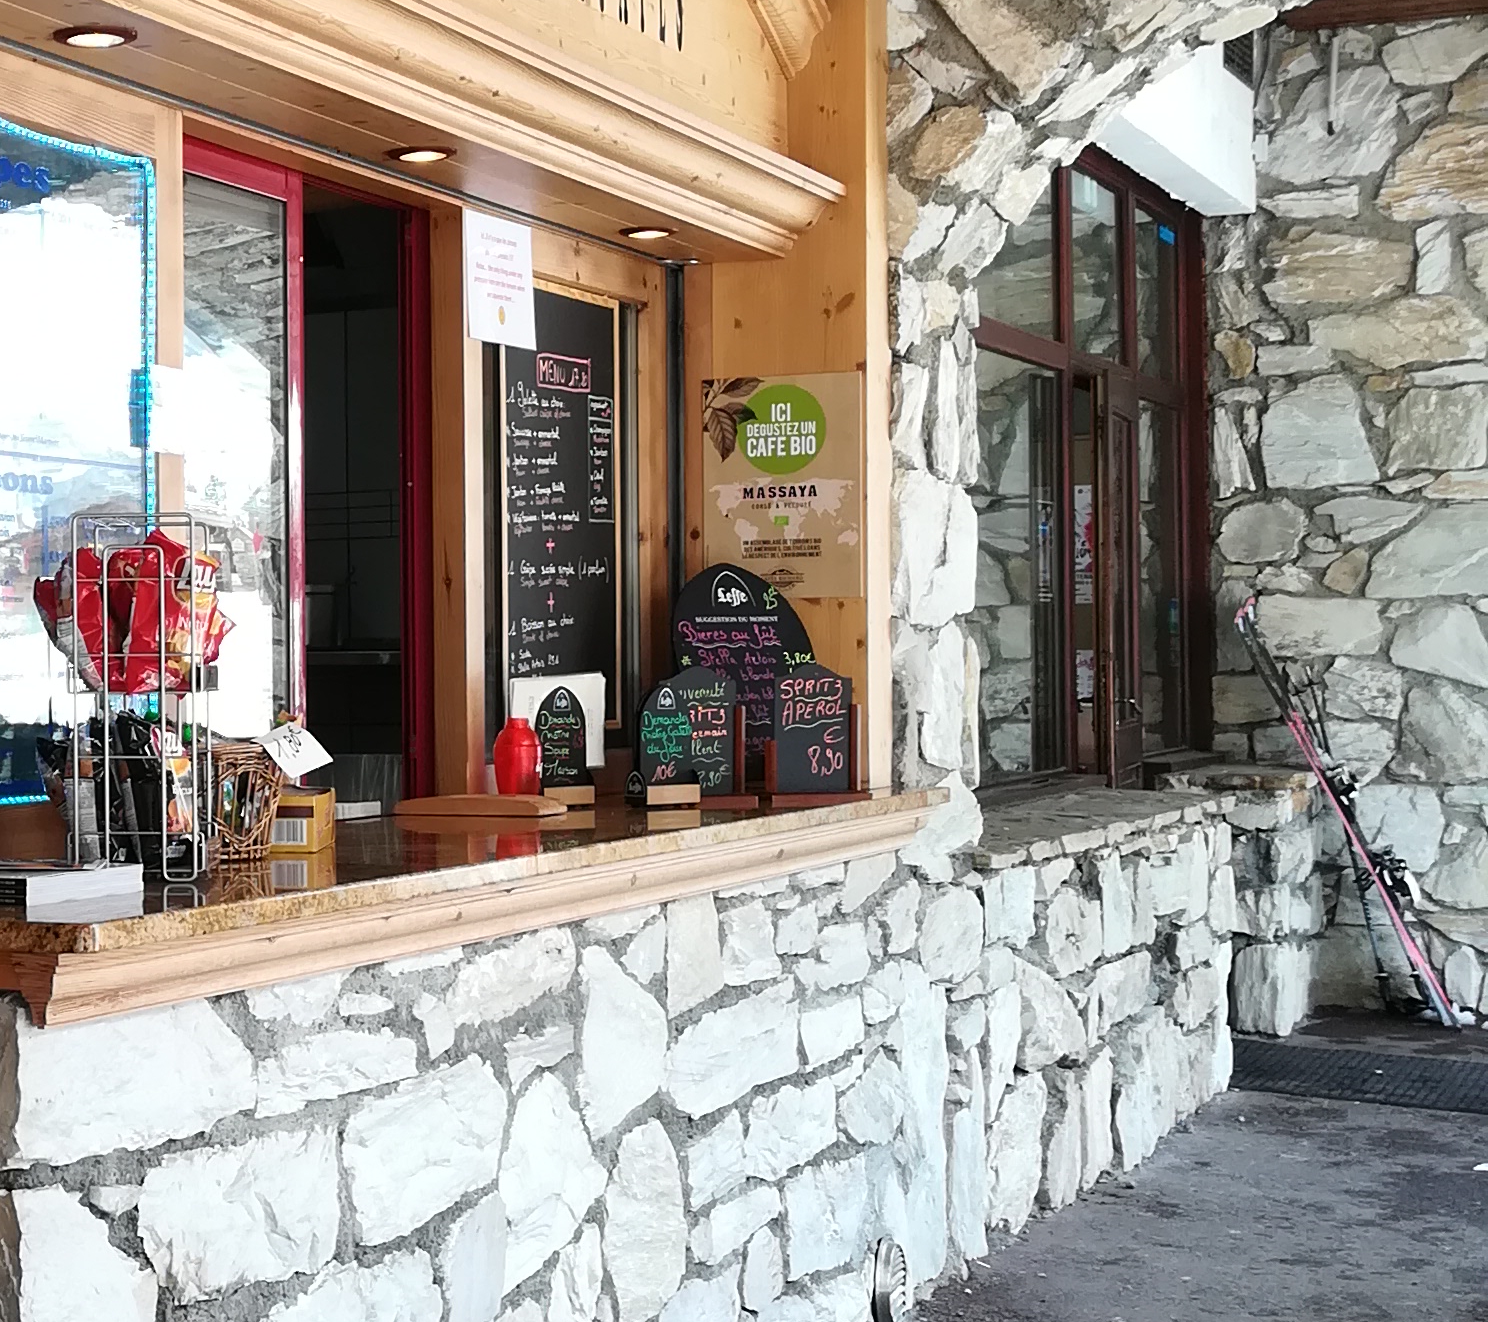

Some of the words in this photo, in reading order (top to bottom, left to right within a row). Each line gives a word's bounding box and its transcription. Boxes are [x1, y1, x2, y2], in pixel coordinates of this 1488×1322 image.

[540, 359, 566, 384] MENU
[771, 403, 791, 422] ICI
[746, 422, 799, 437] DEGUSTEZ
[800, 421, 816, 435] UN
[746, 435, 786, 457] CAFE
[790, 435, 816, 457] BIO
[742, 485, 818, 499] MASSAYA
[718, 587, 748, 607] Leffe
[695, 615, 732, 623] SUGGESTION
[750, 615, 778, 623] MOMENT
[732, 631, 750, 641] au
[698, 649, 738, 667] Stella
[744, 651, 776, 664] Artois
[740, 666, 776, 681] blonde
[782, 700, 847, 725] APEROL
[824, 726, 844, 743] €
[808, 745, 844, 777] 8,90
